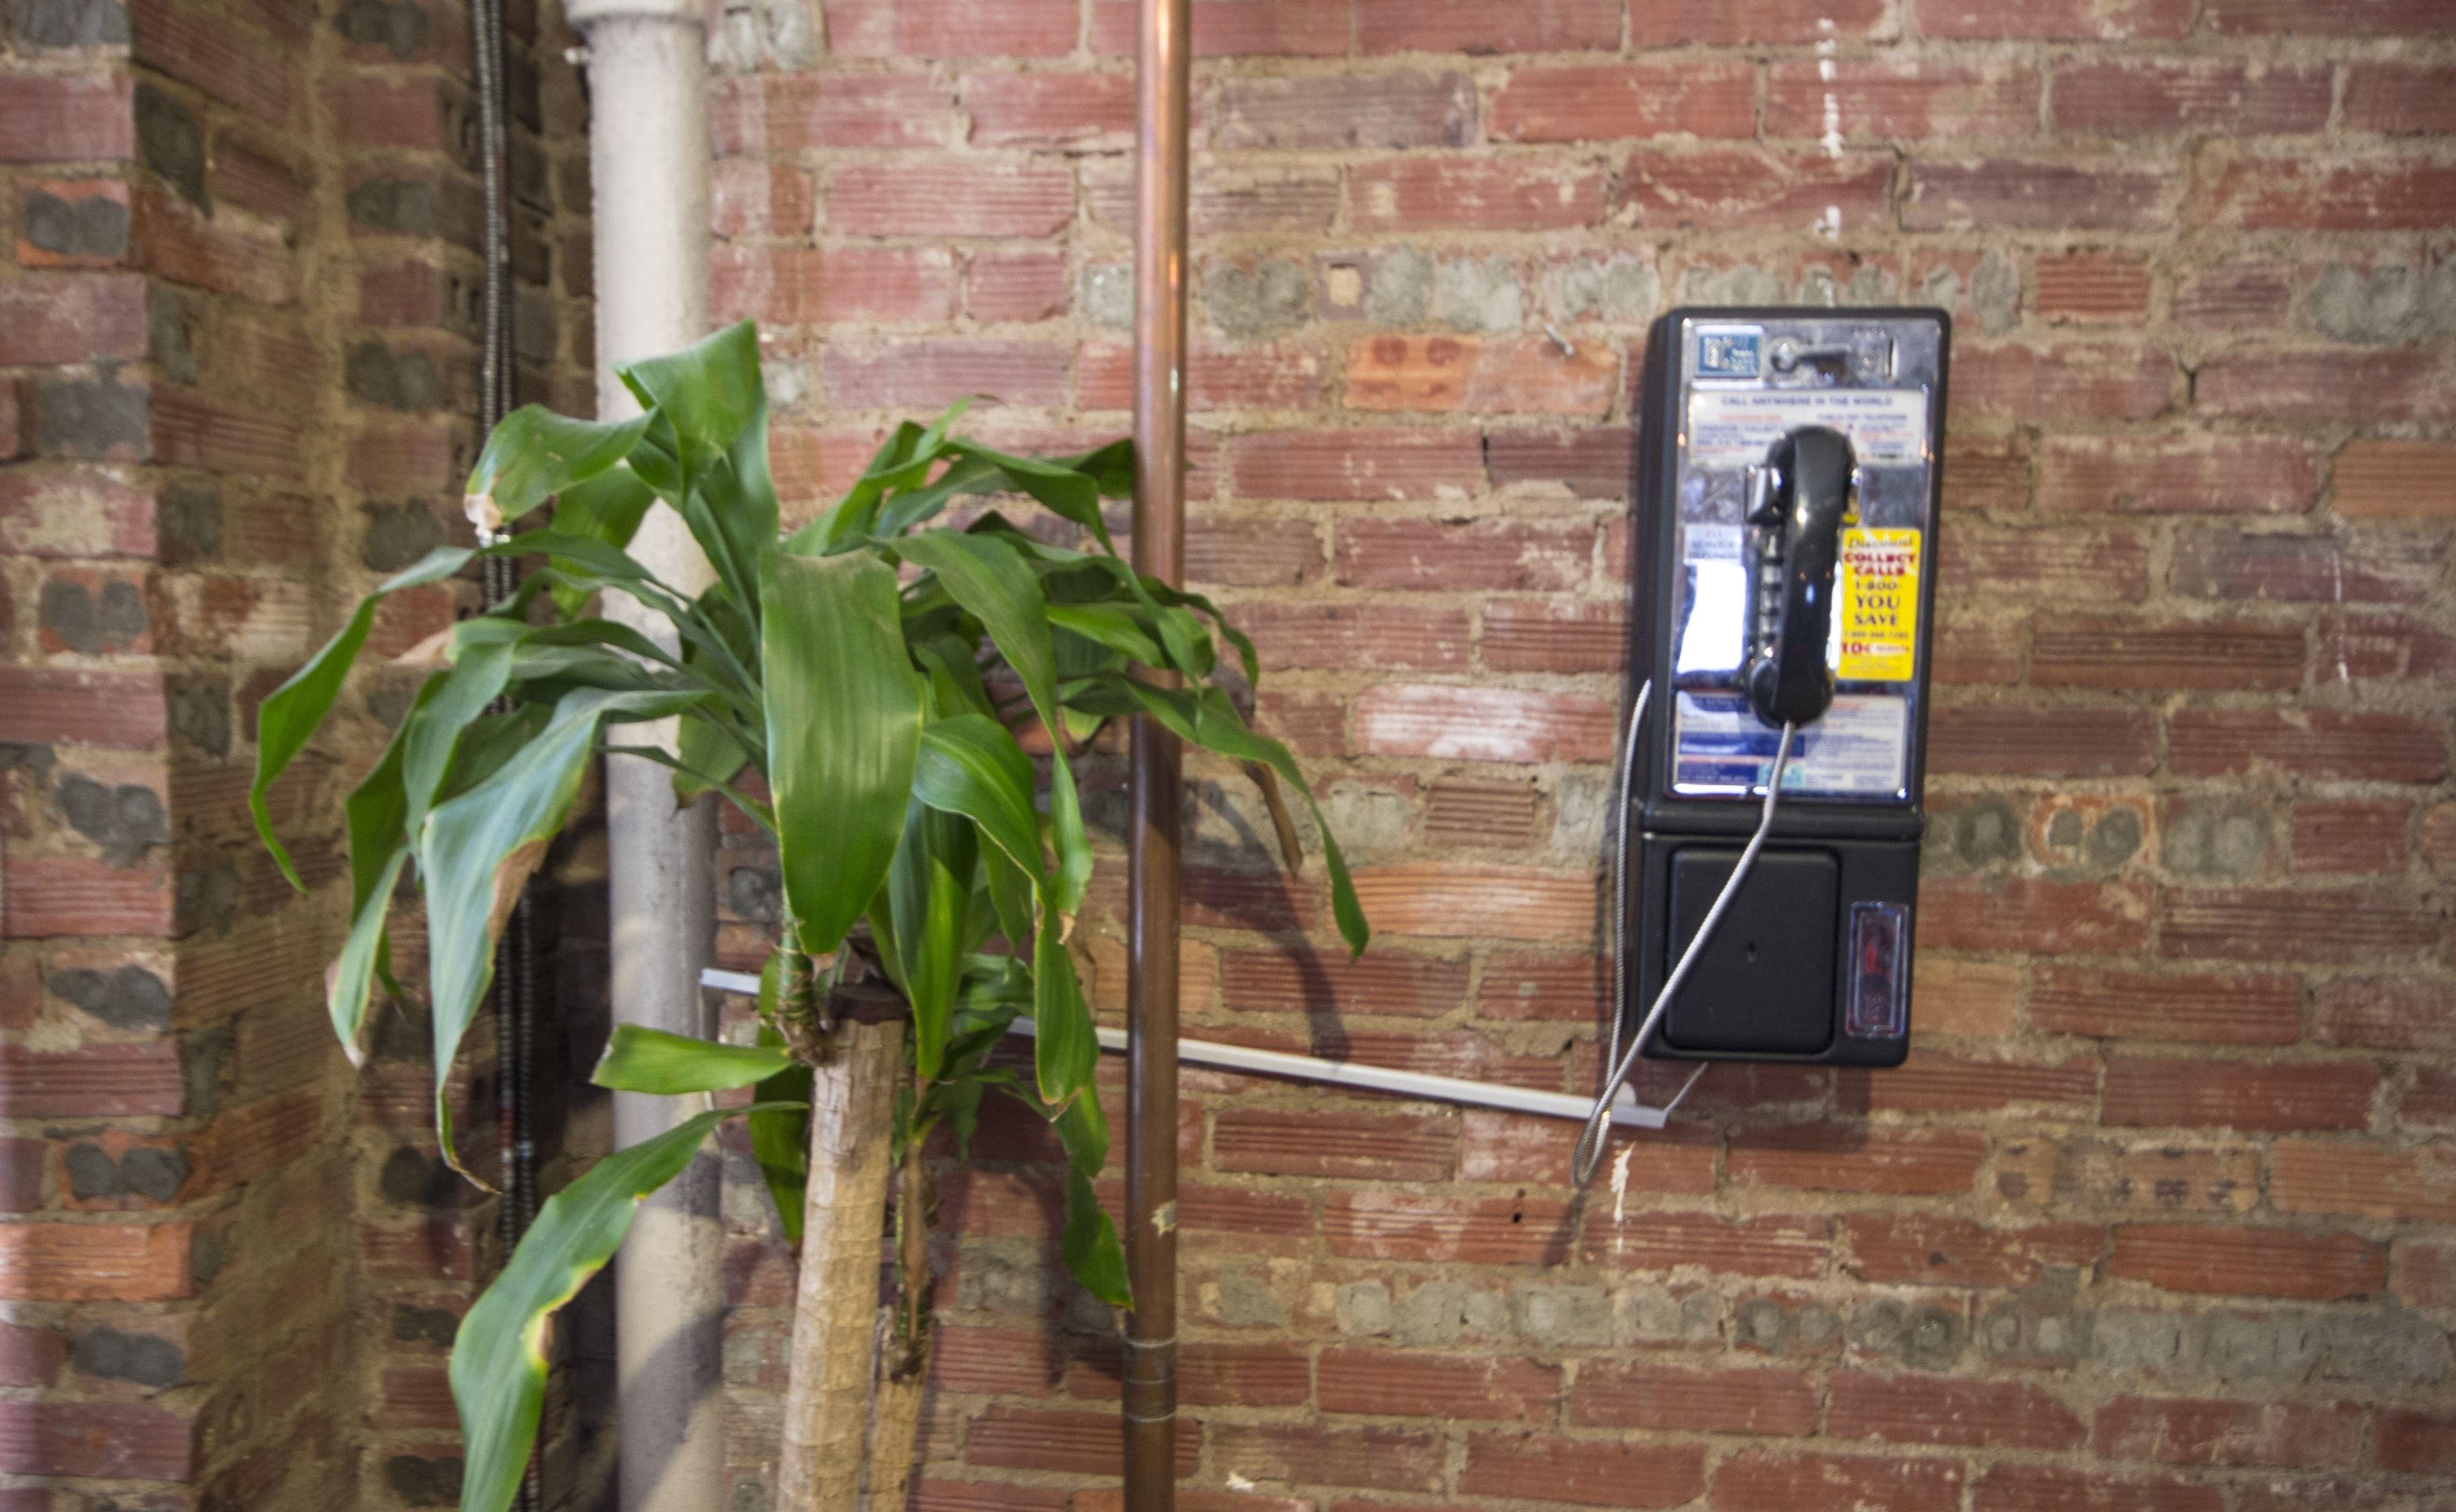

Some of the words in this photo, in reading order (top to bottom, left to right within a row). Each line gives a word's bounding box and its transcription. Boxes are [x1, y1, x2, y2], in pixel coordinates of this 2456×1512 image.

[1721, 397, 1747, 406] CALL
[1752, 397, 1811, 406] ANYWHERE
[1815, 397, 1825, 406] IN
[1829, 397, 1848, 406] THE
[1853, 397, 1893, 406] WORLD
[1843, 552, 1916, 563] COLLECT
[1854, 565, 1905, 576] CALLS
[1855, 594, 1900, 610] YOU
[1854, 613, 1898, 626] SAVE
